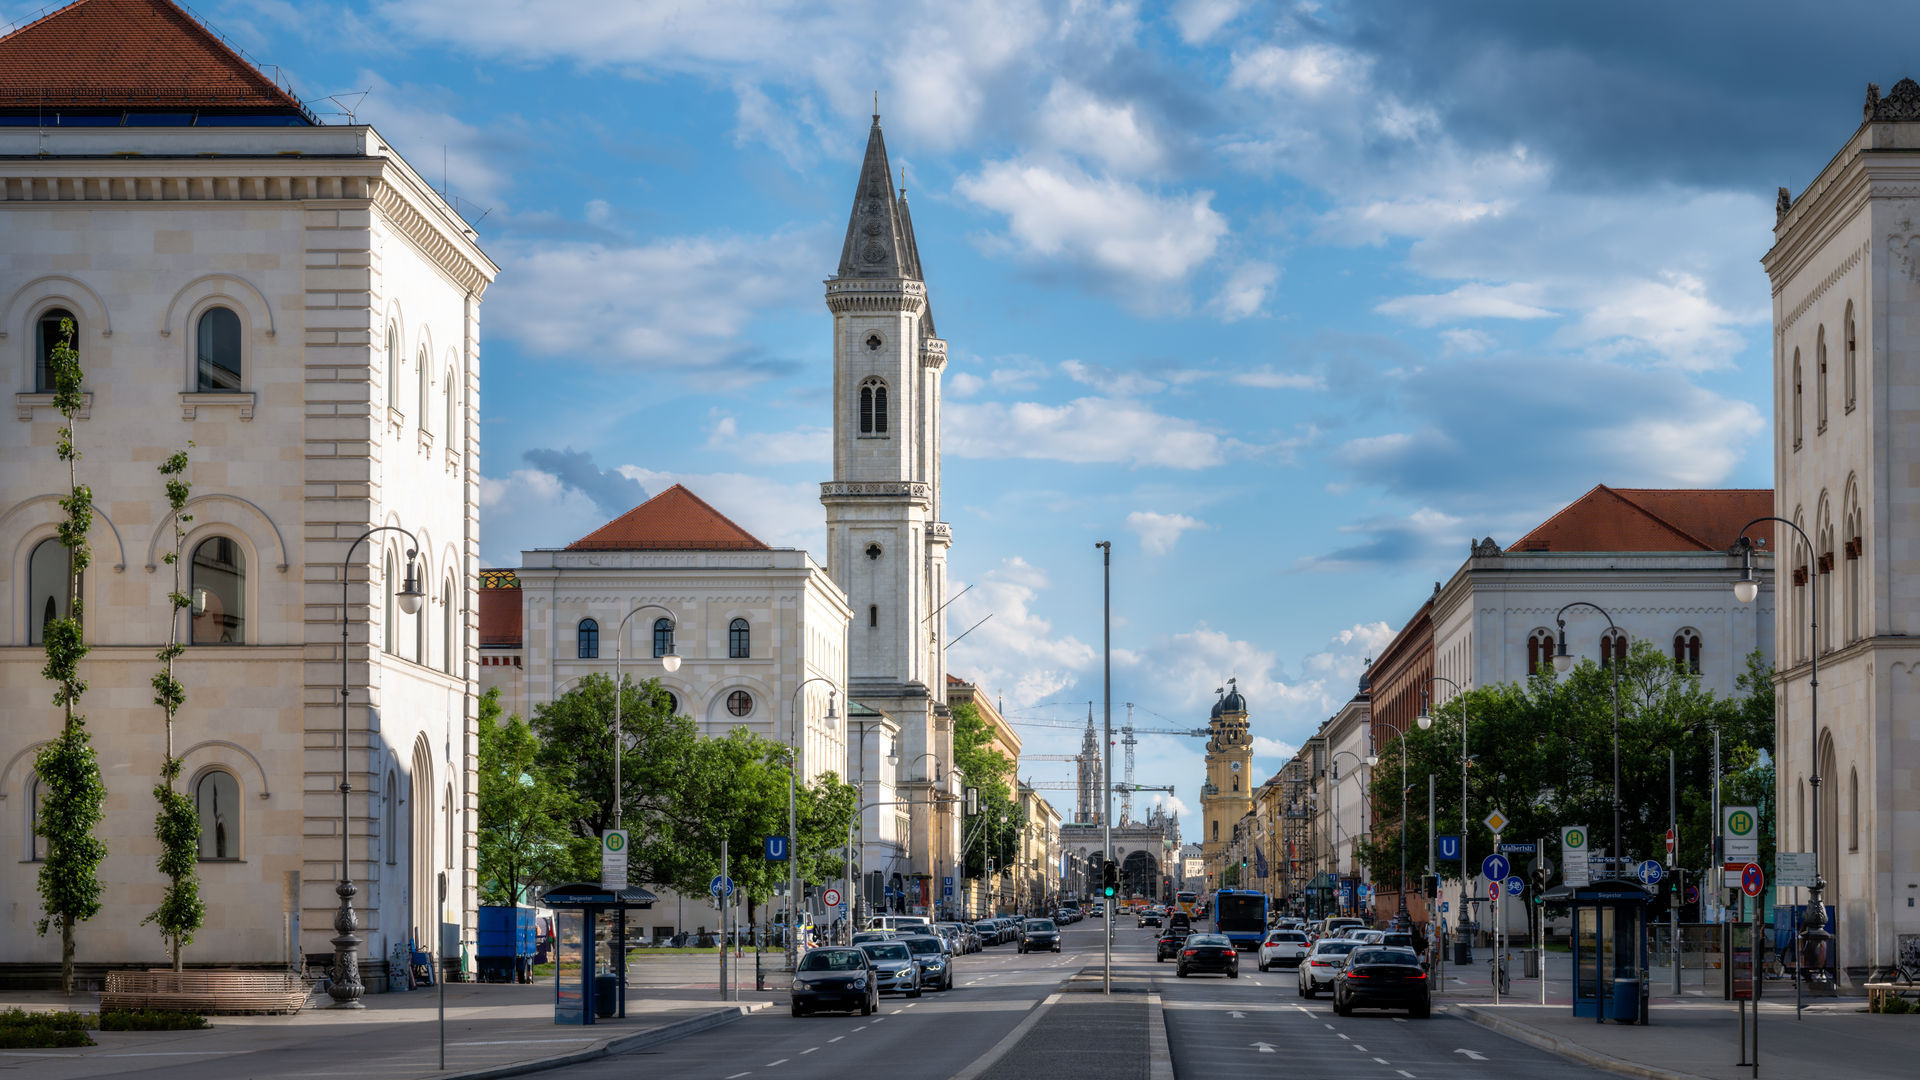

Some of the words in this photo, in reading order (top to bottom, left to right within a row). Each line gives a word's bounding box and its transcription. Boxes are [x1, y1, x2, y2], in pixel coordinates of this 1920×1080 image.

[1735, 816, 1746, 830] H
[610, 837, 619, 848] H
[1571, 834, 1579, 844] H
[770, 840, 783, 856] U
[1443, 840, 1455, 856] U
